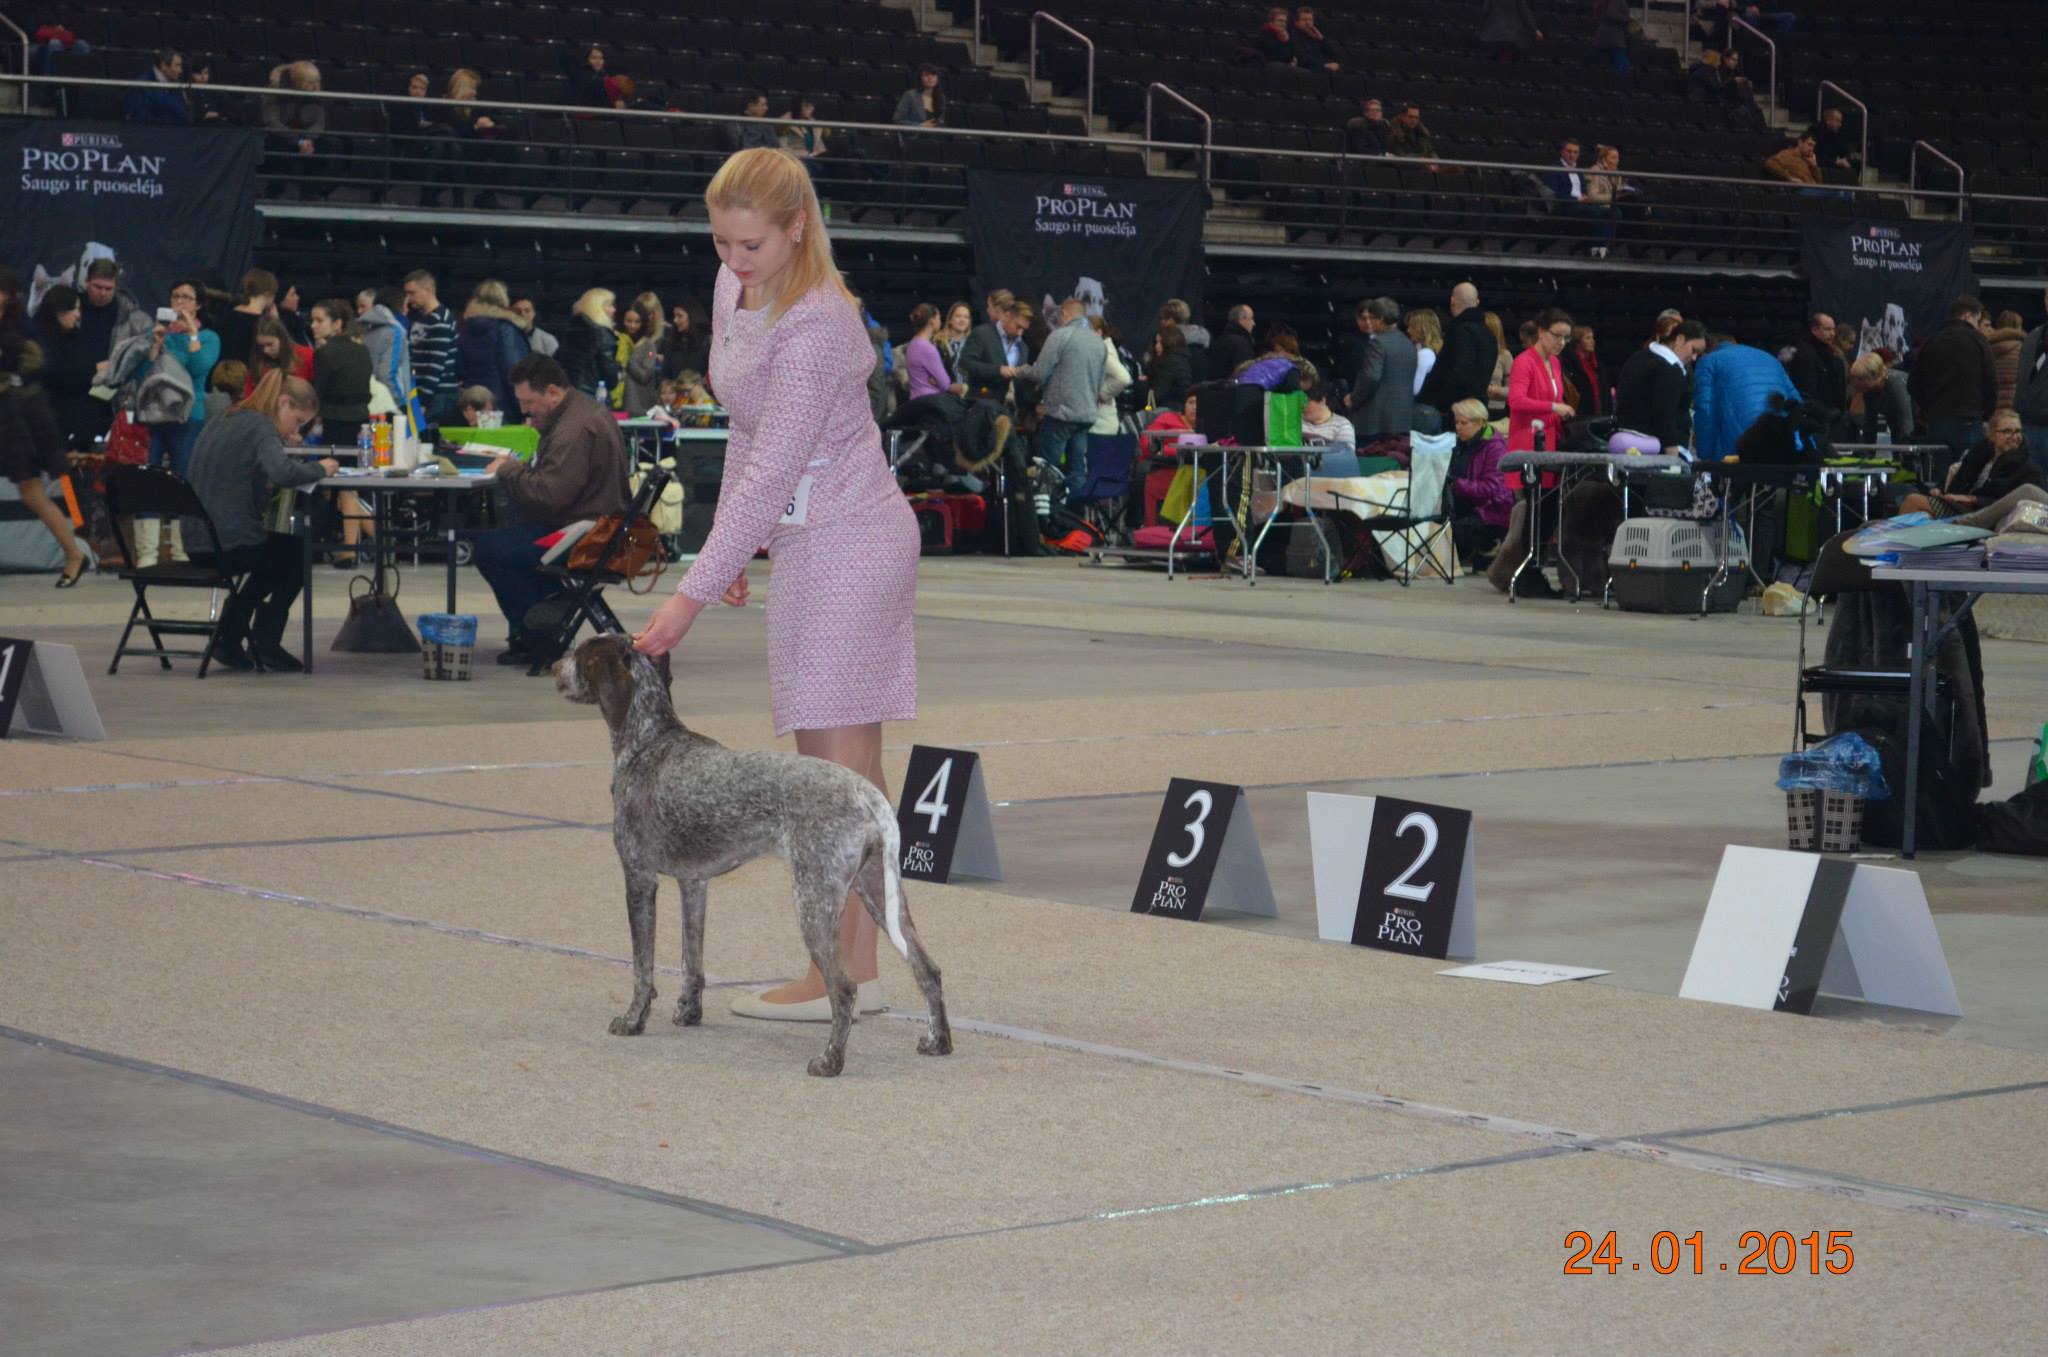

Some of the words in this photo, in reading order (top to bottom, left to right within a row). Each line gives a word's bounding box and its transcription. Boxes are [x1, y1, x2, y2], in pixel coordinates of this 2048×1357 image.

[75, 134, 119, 147] PURINA
[21, 173, 70, 195] Saugo
[75, 174, 89, 191] ir
[1034, 217, 1071, 235] Saugo
[1073, 219, 1082, 232] ir
[0, 644, 15, 703] 1
[913, 757, 953, 834] 4
[1167, 789, 1213, 868] 3
[908, 845, 934, 862] PRO
[1383, 811, 1439, 902] 2
[902, 857, 935, 873] PLAN
[1159, 880, 1187, 898] PRO
[1152, 893, 1186, 910] PLAN
[1383, 912, 1422, 933] PRO
[1377, 925, 1424, 947] PLAN
